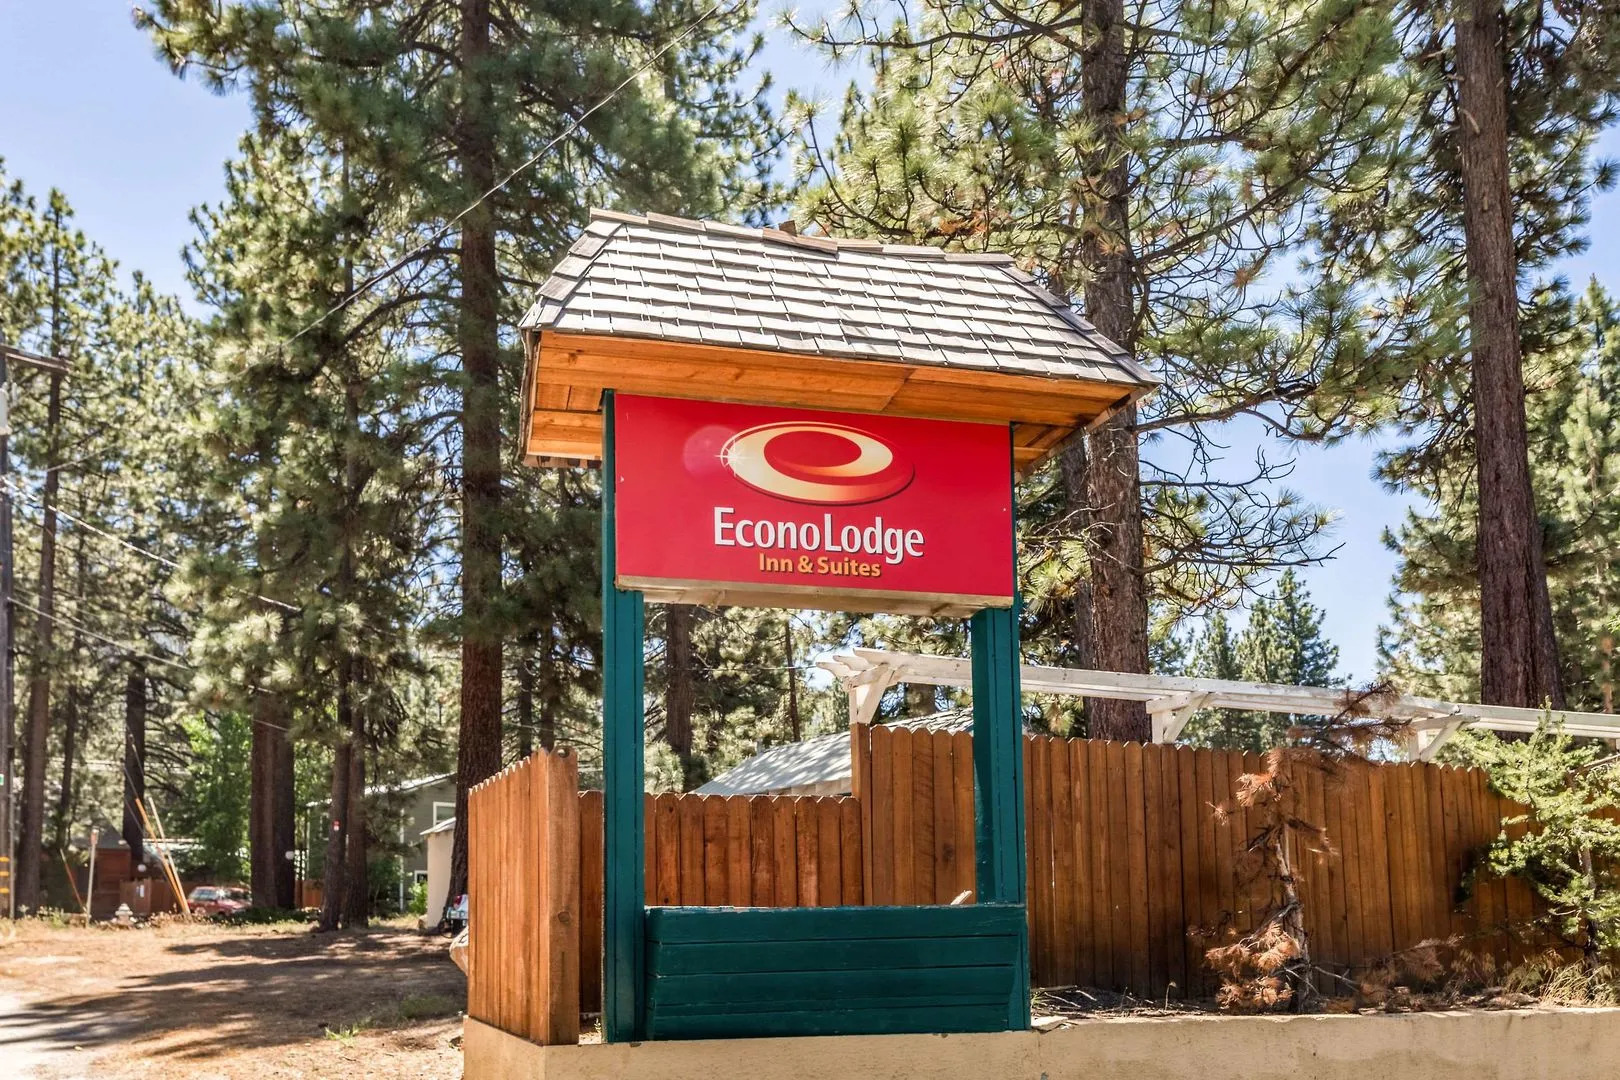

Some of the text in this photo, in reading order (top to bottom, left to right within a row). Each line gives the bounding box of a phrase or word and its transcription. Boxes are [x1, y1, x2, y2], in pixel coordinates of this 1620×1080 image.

[758, 552, 881, 578] Inn & Suites
